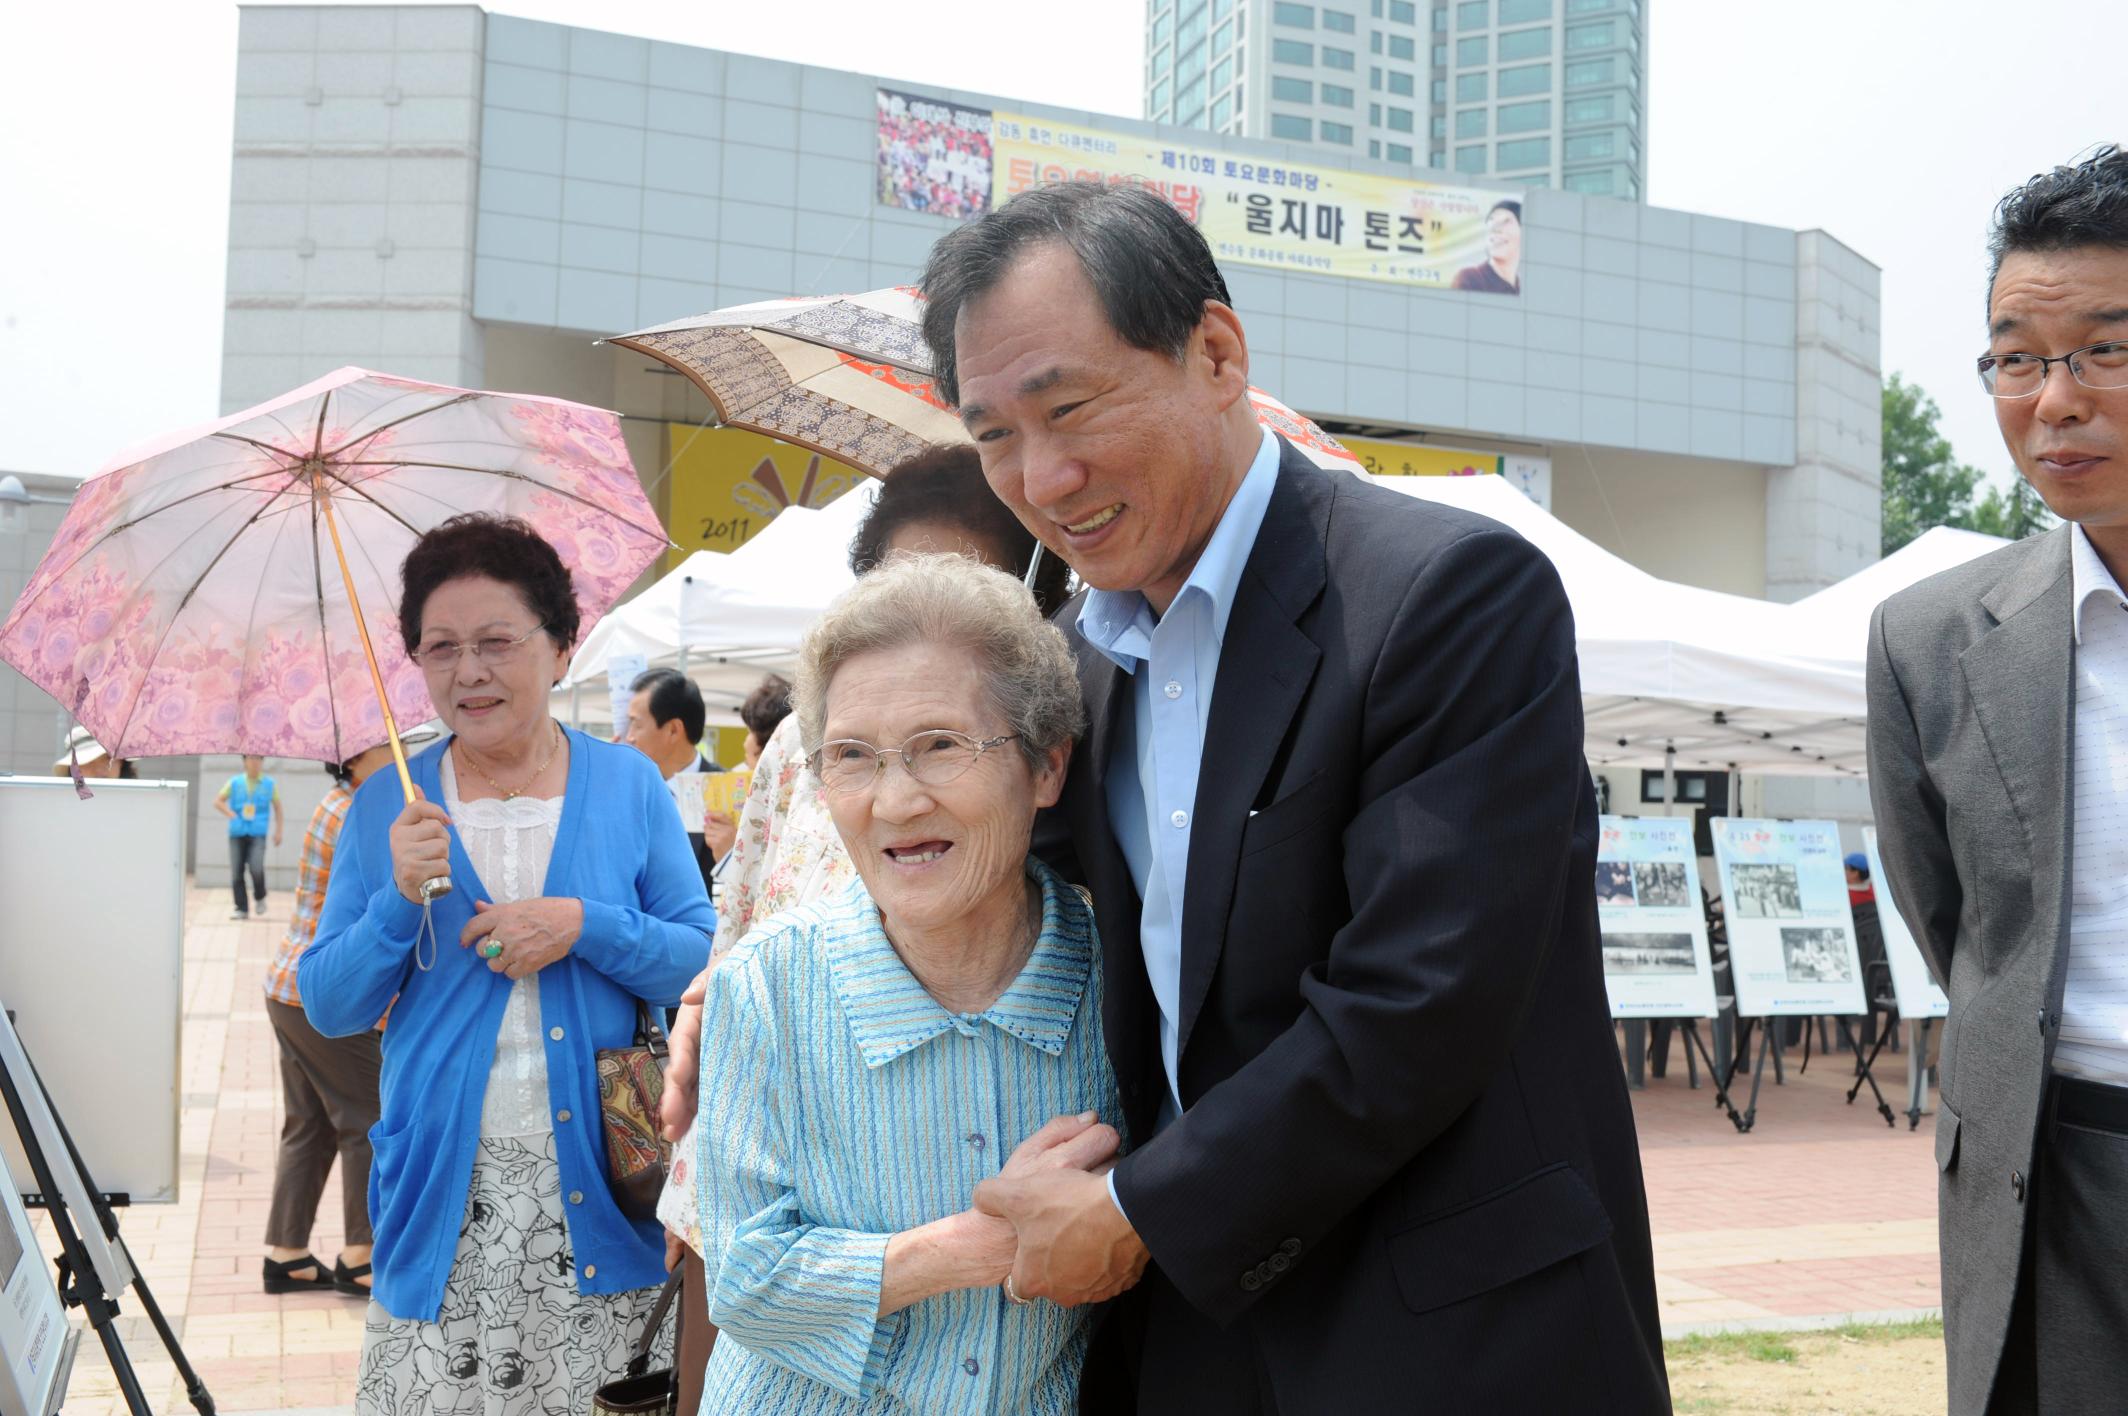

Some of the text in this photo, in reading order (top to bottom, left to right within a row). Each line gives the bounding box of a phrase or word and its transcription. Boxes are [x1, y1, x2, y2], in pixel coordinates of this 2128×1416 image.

[1160, 150, 1216, 176] 제10회
[1223, 161, 1319, 192] 토요문화마당
[701, 518, 751, 543] 2011
